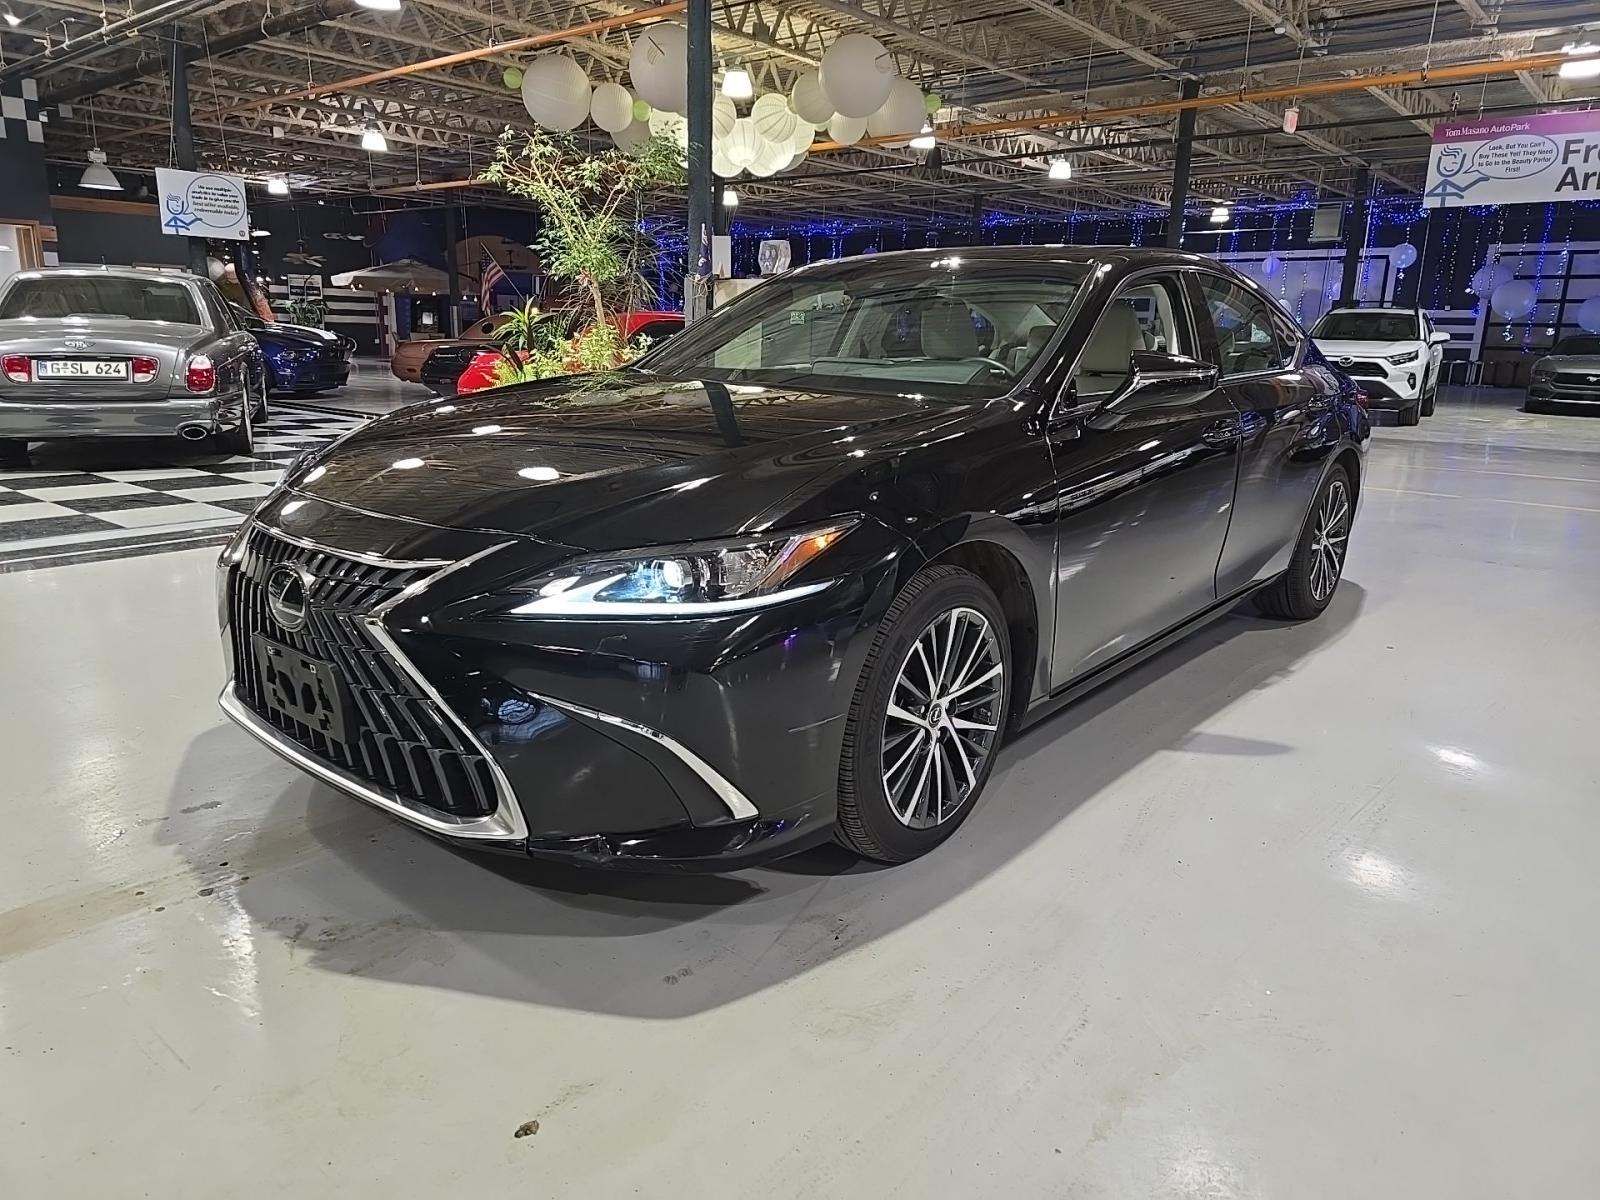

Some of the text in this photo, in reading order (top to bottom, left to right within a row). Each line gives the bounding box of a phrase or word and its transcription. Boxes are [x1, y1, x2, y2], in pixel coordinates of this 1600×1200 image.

[1445, 128, 1460, 137] Tom
[1461, 126, 1489, 136] Masano
[1562, 138, 1600, 165] Fr
[1512, 157, 1533, 165] Beauty
[1554, 166, 1600, 193] Ar
[95, 363, 121, 375] 624
